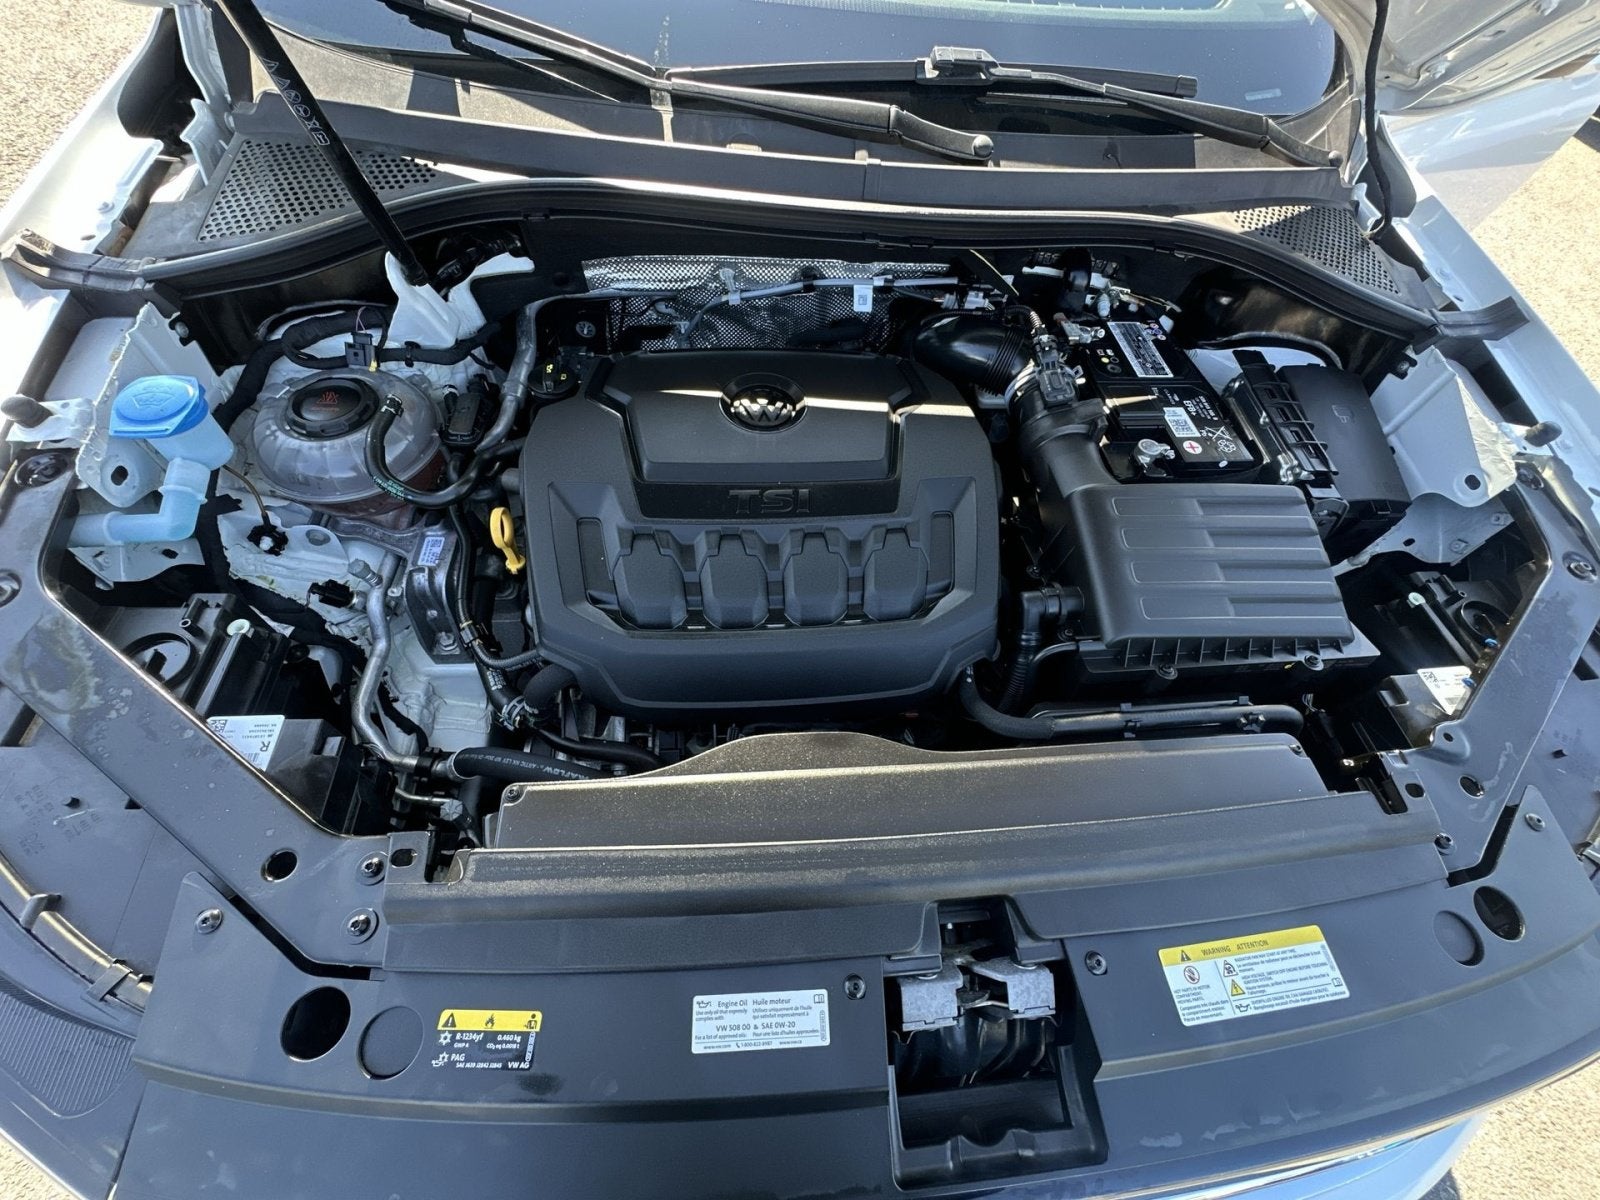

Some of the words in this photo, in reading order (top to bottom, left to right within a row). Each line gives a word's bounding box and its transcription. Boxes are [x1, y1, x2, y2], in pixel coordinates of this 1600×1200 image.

[728, 488, 810, 514] TSI
[260, 740, 271, 752] R
[1201, 943, 1231, 956] WARNING
[1236, 940, 1268, 952] ATTENTION
[718, 1000, 738, 1009] Engine
[774, 1021, 796, 1029] 0W-20
[456, 1033, 484, 1043] R-1234yf
[514, 1034, 522, 1043] kg
